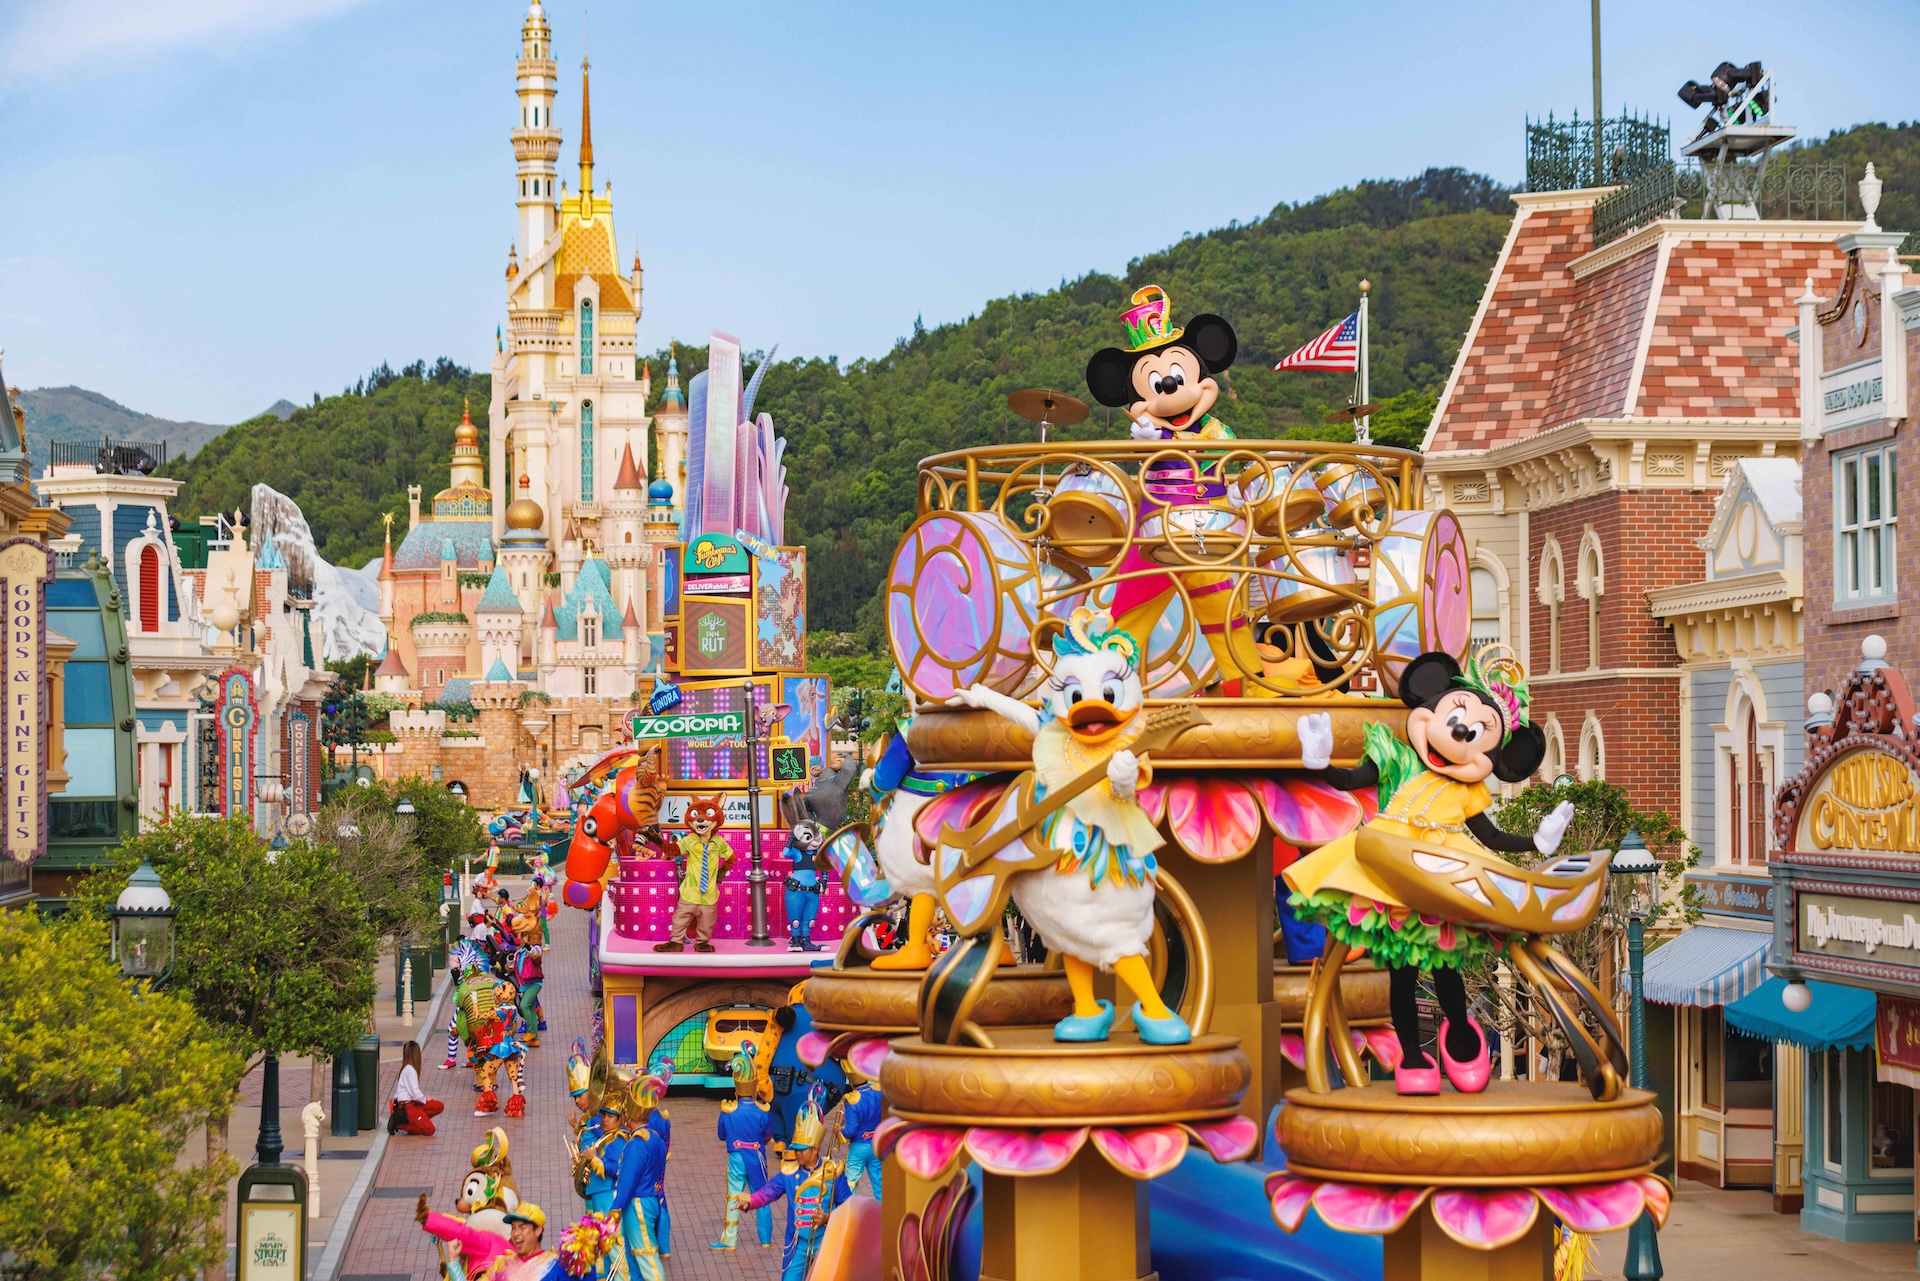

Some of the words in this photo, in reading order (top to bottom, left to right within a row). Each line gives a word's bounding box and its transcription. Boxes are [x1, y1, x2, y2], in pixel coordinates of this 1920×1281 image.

[735, 531, 779, 562] COWTOWN
[687, 583, 729, 591] DELIVERabbit
[14, 584, 31, 659] GOODS
[701, 637, 725, 653] RUT
[13, 670, 31, 682] &
[652, 690, 680, 713] TUNDRA
[15, 693, 30, 753] FINE
[635, 714, 742, 739] ZOOTOPIA
[228, 707, 246, 813] CURIOSIT
[294, 723, 303, 811] CONFECTIONS
[14, 764, 30, 839] GIFTS
[1810, 791, 1920, 852] CINEM
[1723, 884, 1760, 909] Cookies
